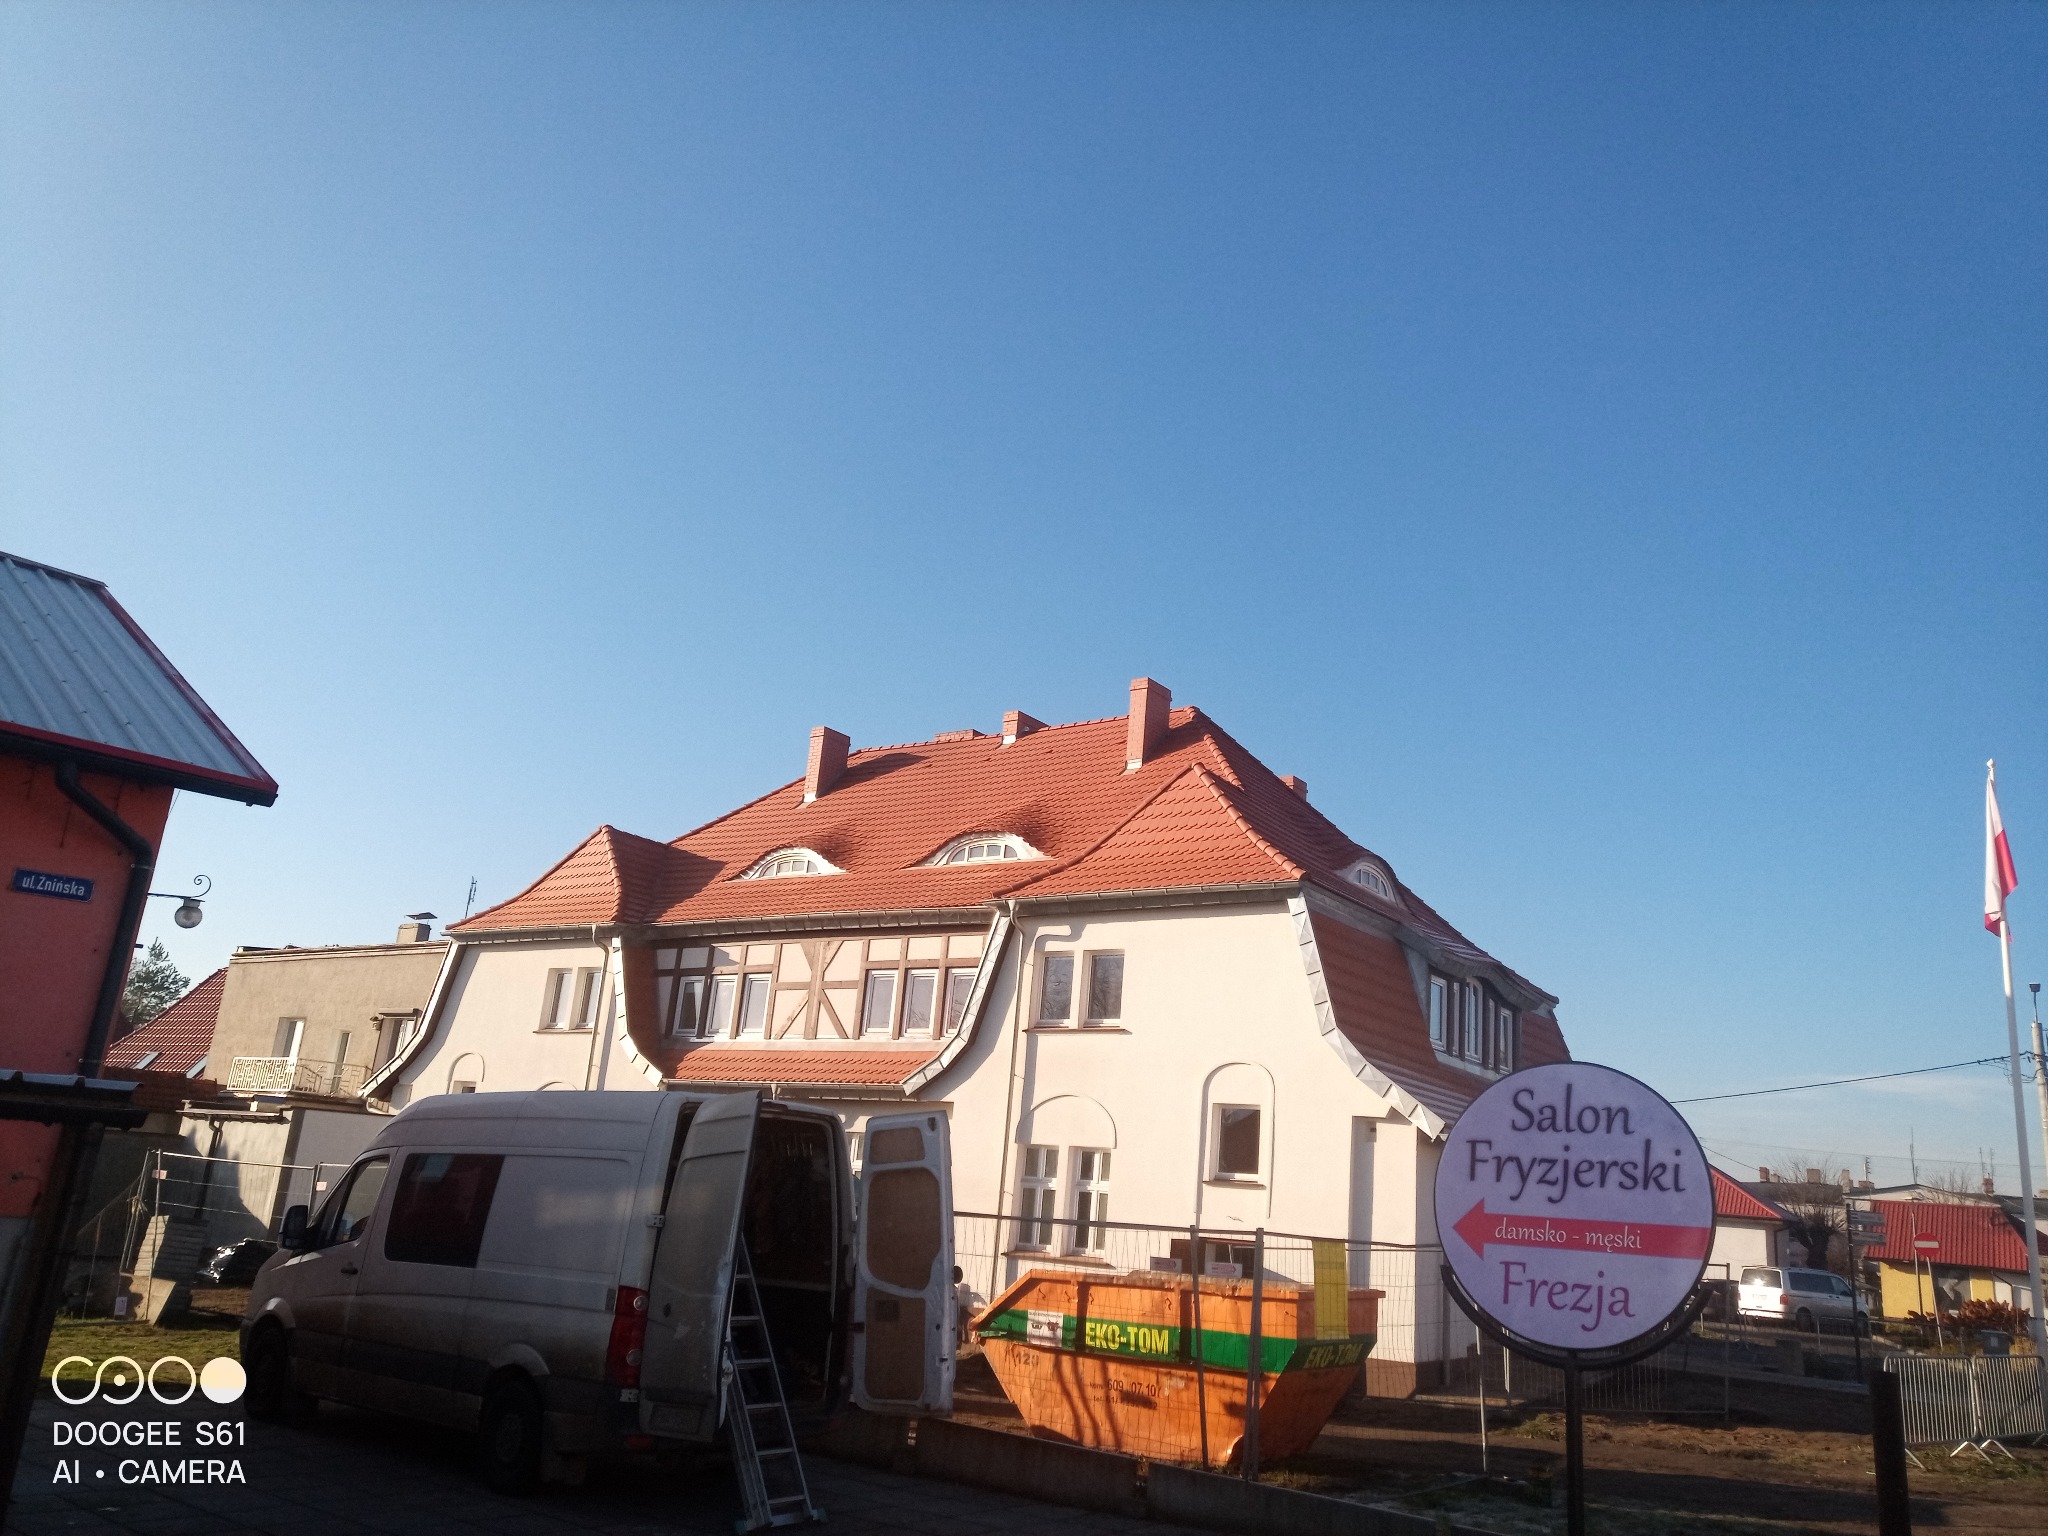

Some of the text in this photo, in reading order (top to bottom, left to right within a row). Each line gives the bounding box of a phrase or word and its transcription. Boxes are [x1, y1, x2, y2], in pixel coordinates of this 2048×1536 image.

[1511, 1083, 1635, 1136] Salon
[1466, 1138, 1686, 1204] Fryzjerski
[1495, 1217, 1567, 1244] damsko
[1585, 1225, 1643, 1253] męski
[1499, 1261, 1636, 1333] Frezja
[1085, 1321, 1169, 1355] EKO-TOM
